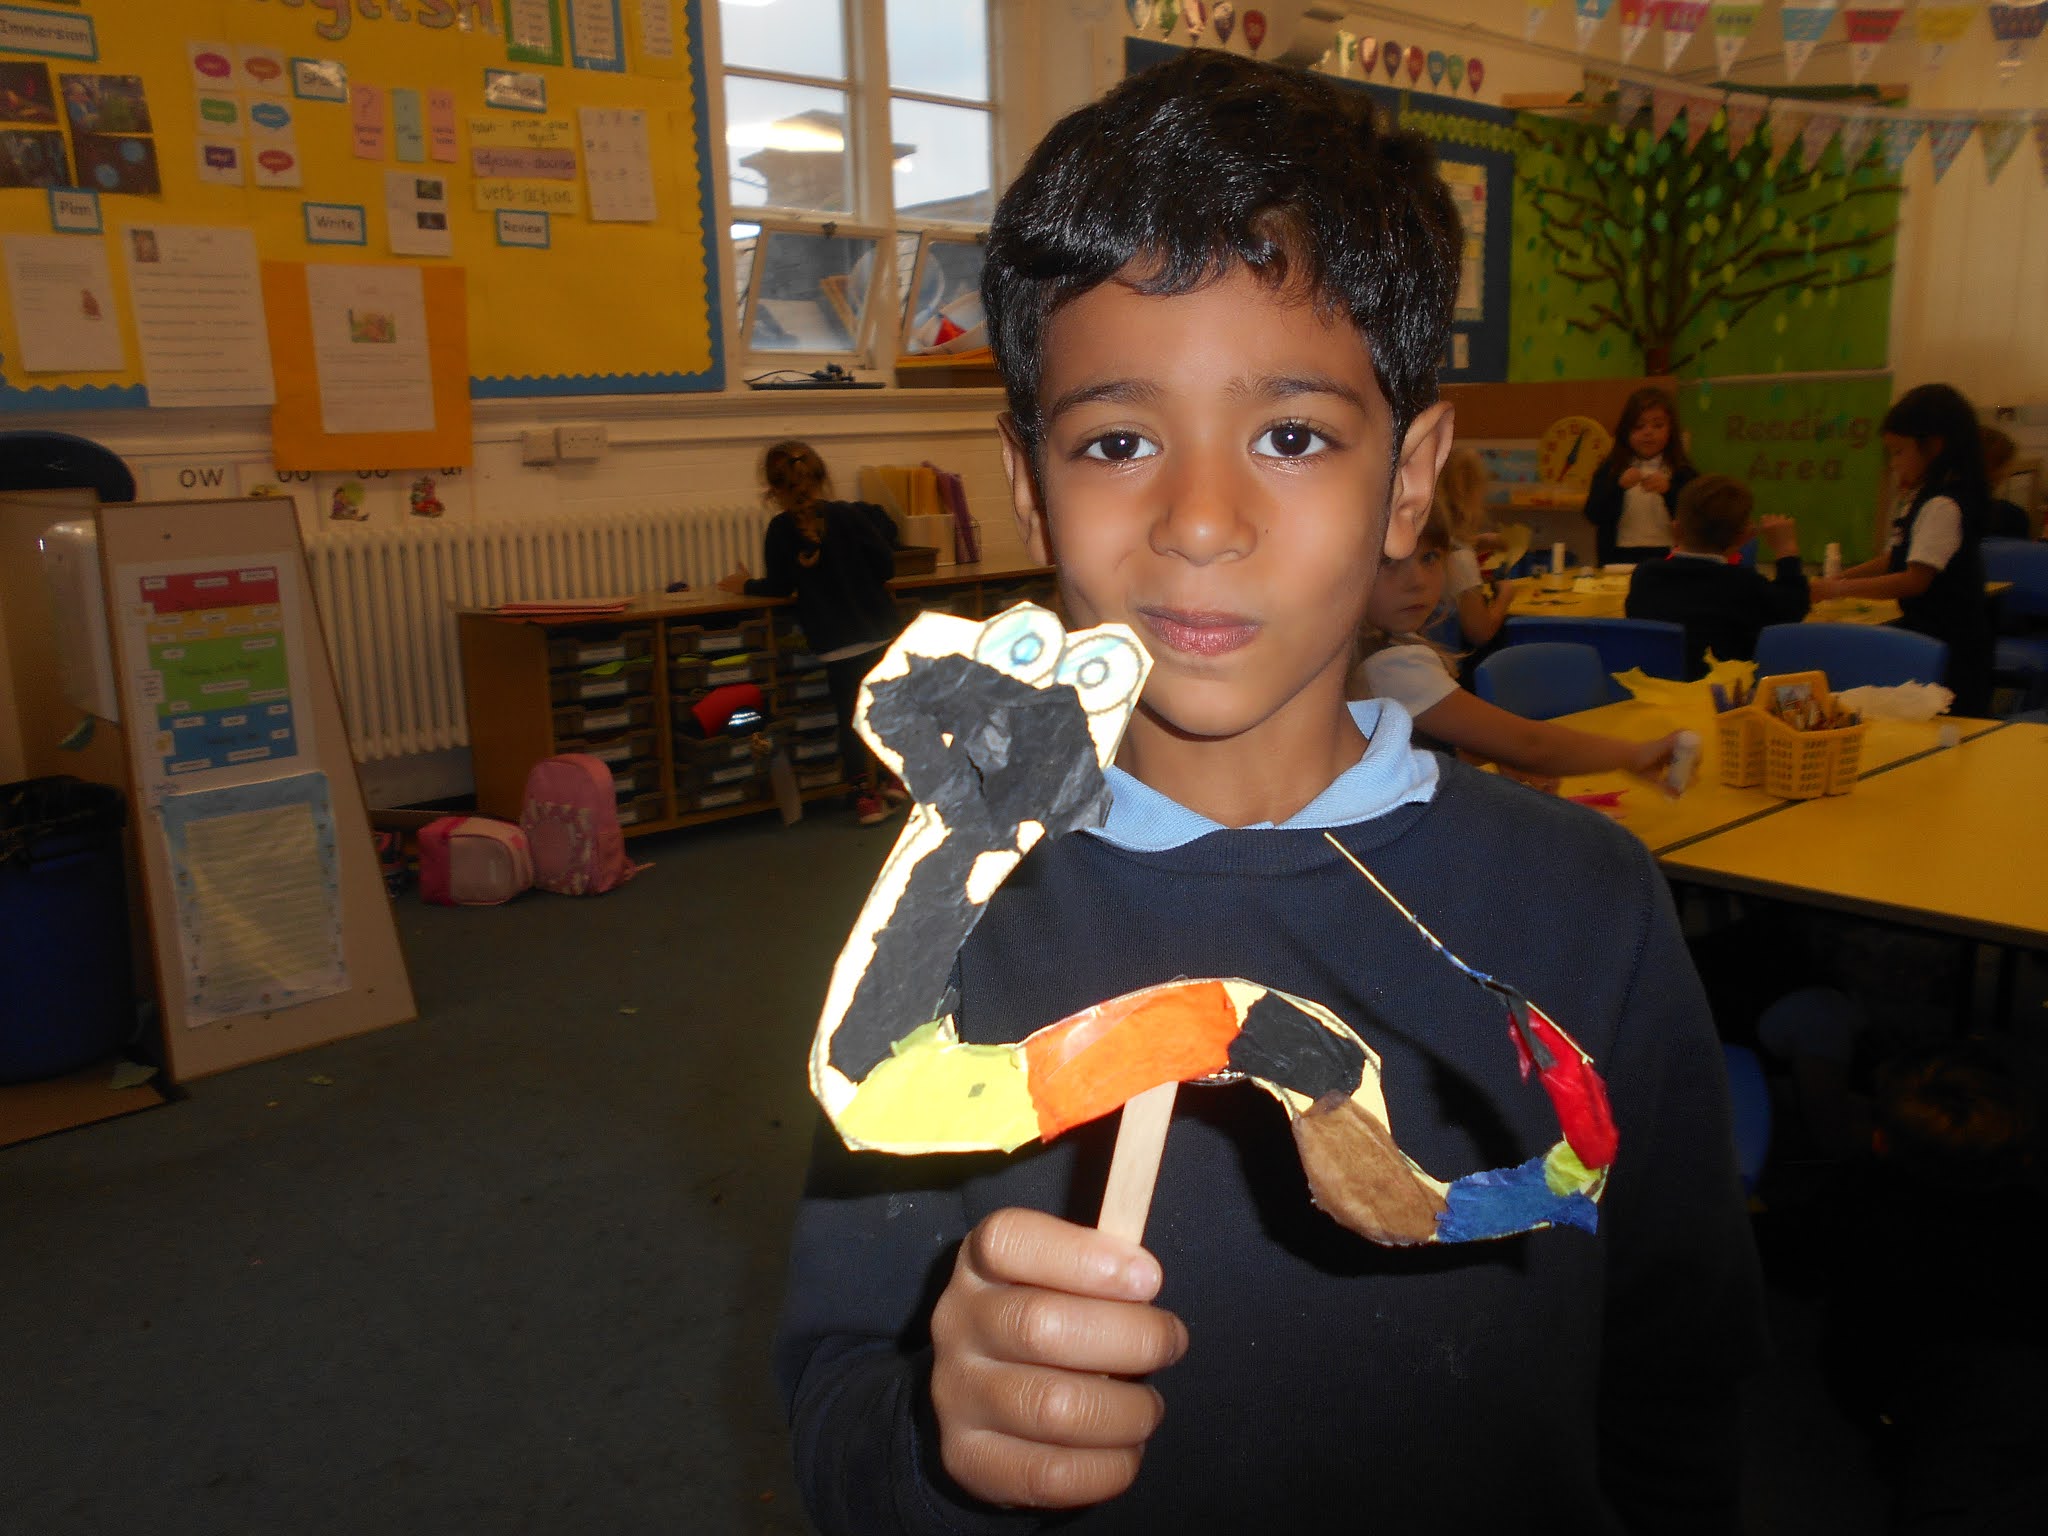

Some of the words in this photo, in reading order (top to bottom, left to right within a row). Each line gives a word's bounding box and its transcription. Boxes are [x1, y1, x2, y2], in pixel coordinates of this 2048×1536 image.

[60, 200, 92, 216] Plan
[314, 215, 355, 232] Write
[503, 221, 543, 235] Review
[1726, 407, 1873, 448] Reading
[1747, 451, 1844, 481] Area
[179, 468, 225, 488] ow
